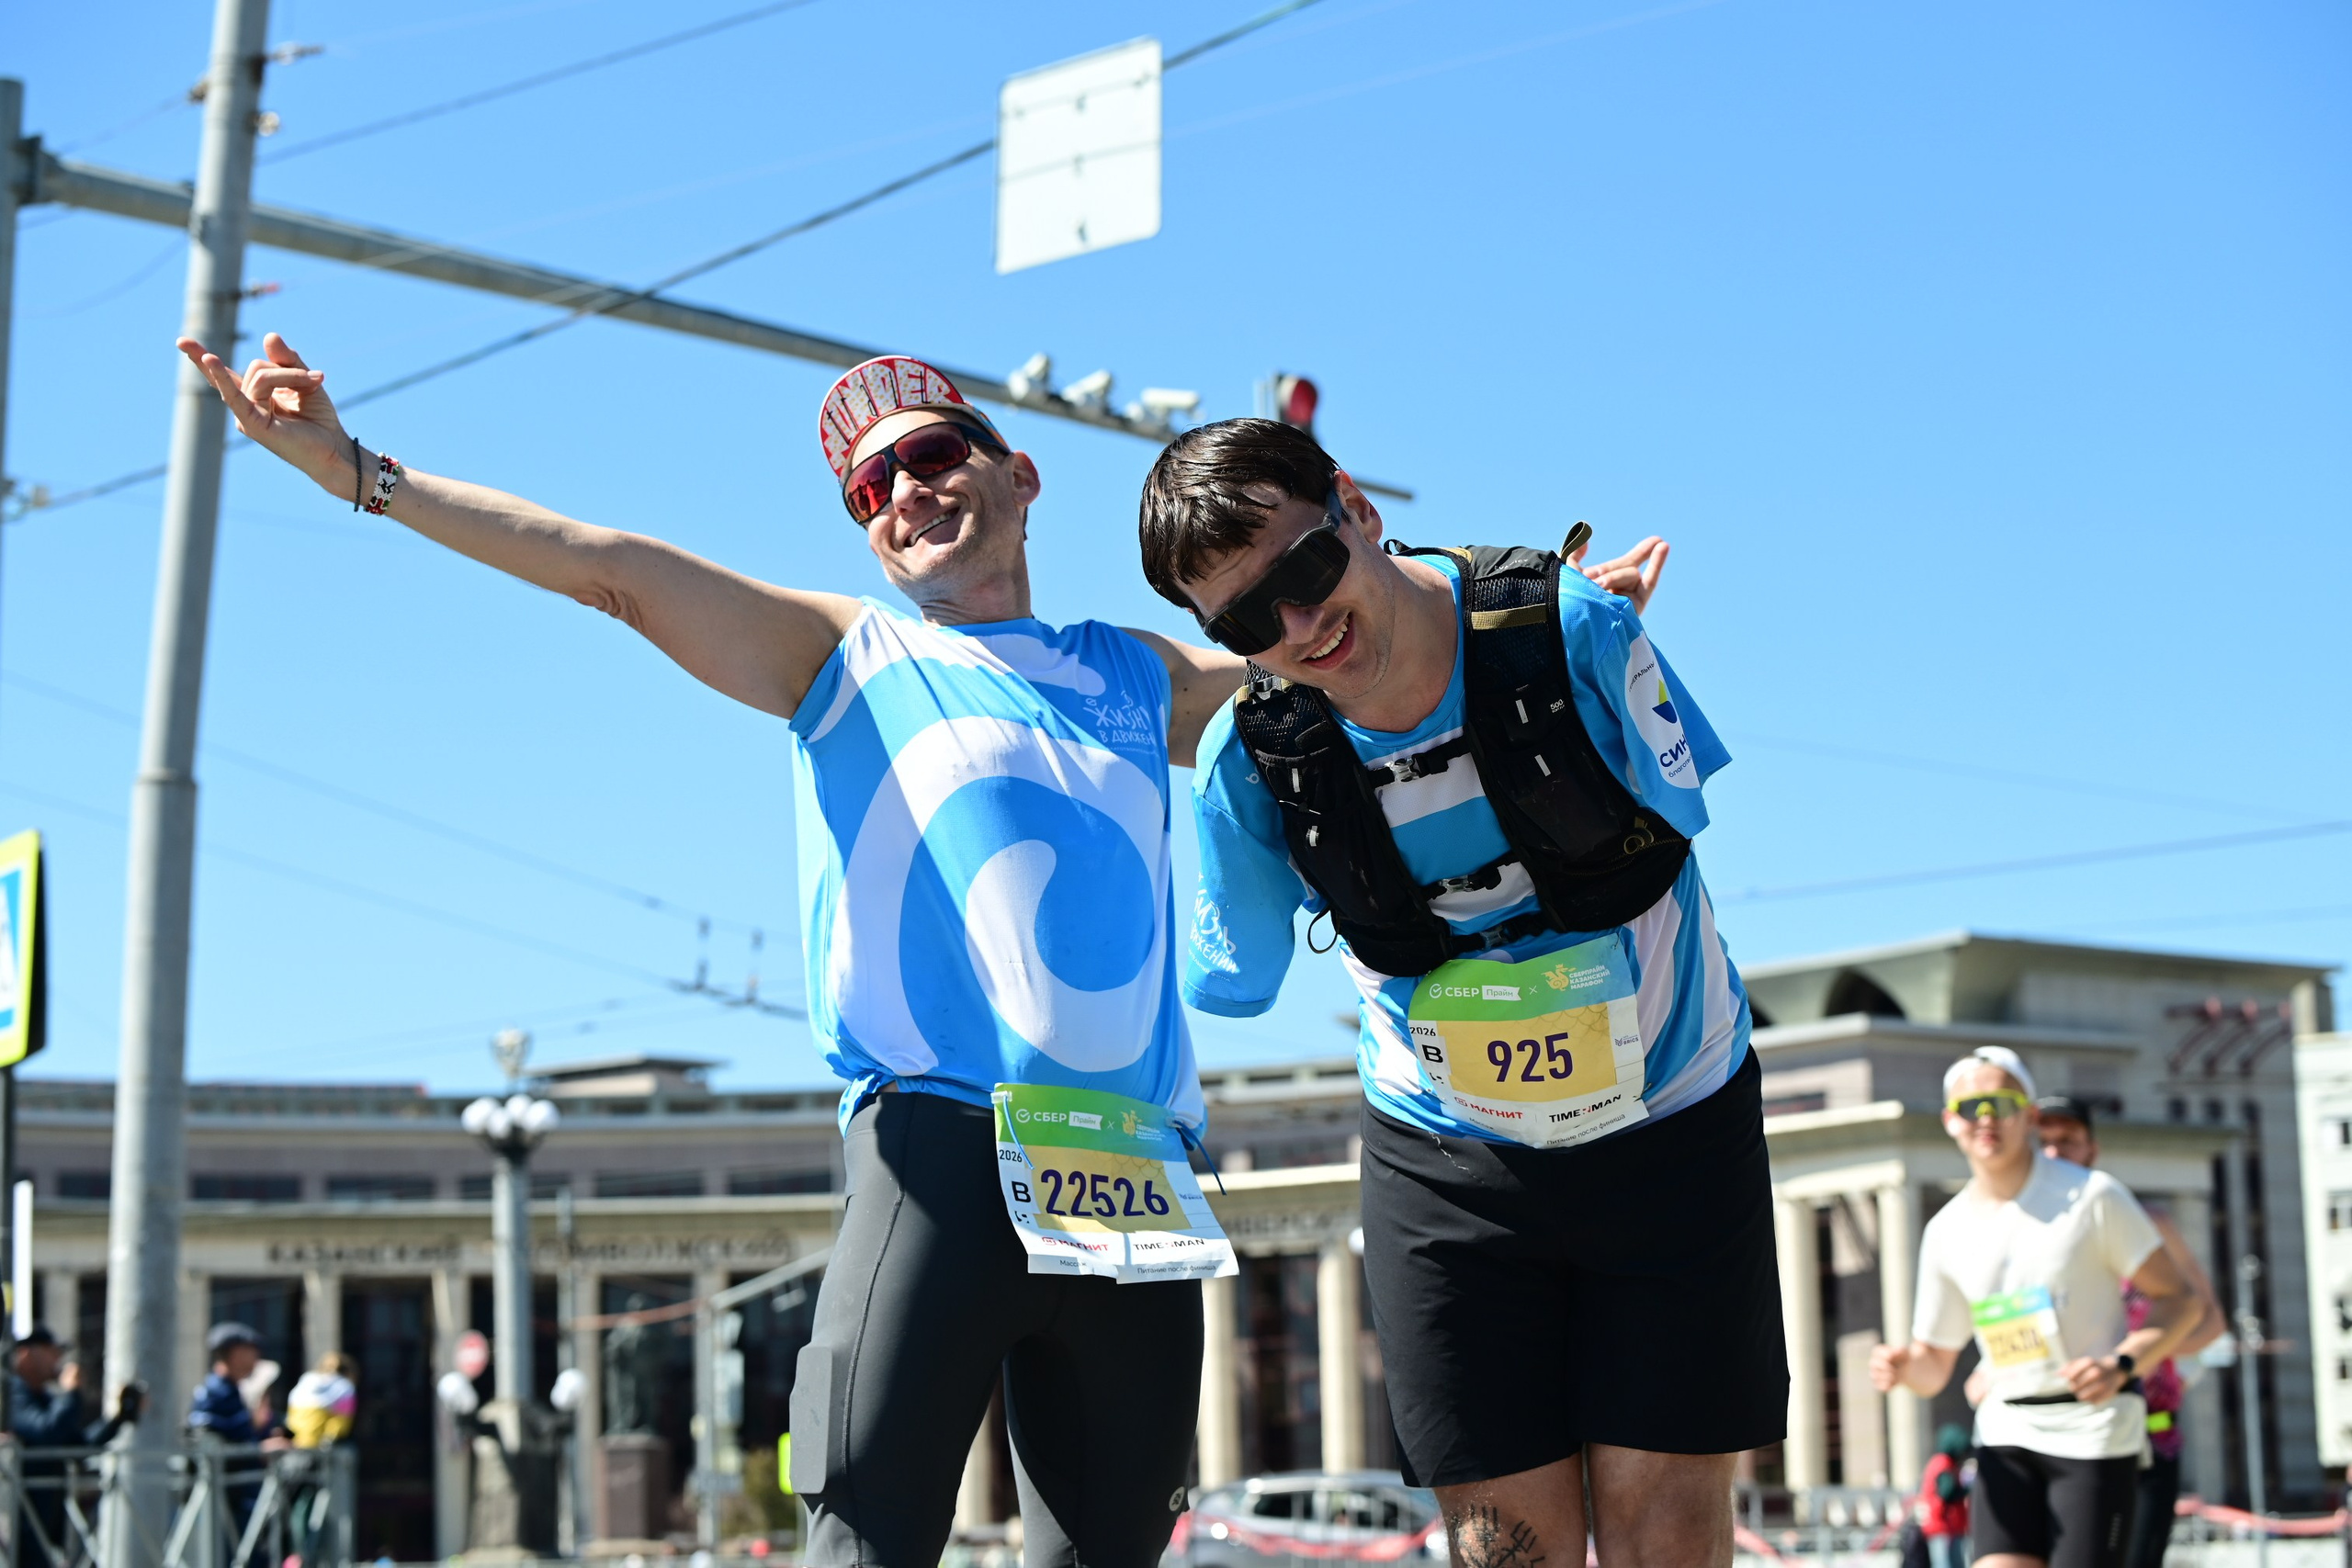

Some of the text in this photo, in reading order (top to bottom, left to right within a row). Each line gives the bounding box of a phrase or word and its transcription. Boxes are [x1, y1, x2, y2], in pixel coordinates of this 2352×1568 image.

[1569, 964, 1606, 978] СБЕРПРАЙМ
[1570, 969, 1611, 984] КАЗАНСКИЙ
[1570, 978, 1604, 989] МАРАФОН
[1444, 987, 1479, 998] СБЕР
[1486, 988, 1514, 998] Прайм
[1409, 1026, 1436, 1037] 2026
[1487, 1032, 1574, 1082] 925
[1033, 1111, 1068, 1123] СБЕР
[1072, 1116, 1096, 1125] Прайм
[1470, 1103, 1523, 1120] МАГНИТ
[1546, 1113, 1626, 1145] Питание после финиша
[999, 1149, 1023, 1163] 2026
[1040, 1168, 1170, 1217] 22526
[1058, 1239, 1109, 1251] МАГНИТ
[1189, 1264, 1216, 1272] финиша
